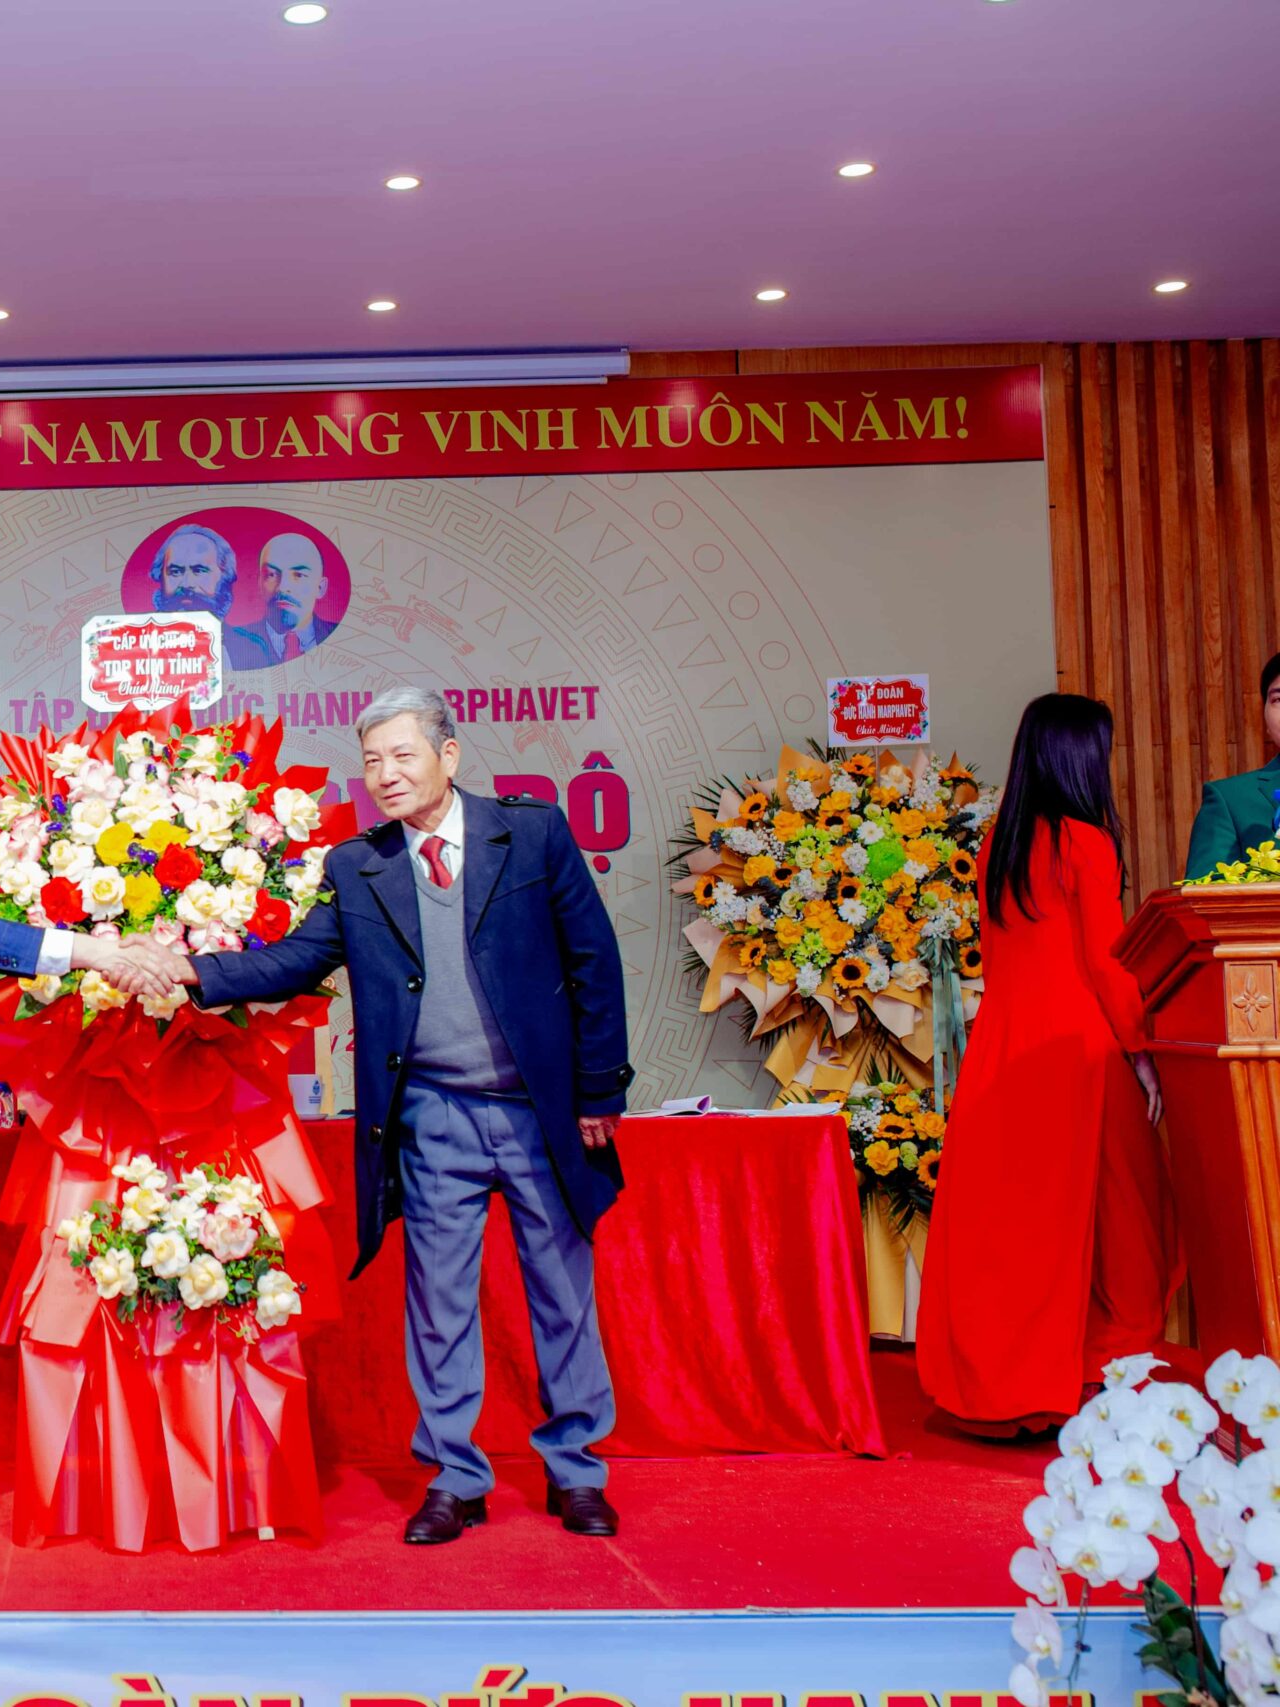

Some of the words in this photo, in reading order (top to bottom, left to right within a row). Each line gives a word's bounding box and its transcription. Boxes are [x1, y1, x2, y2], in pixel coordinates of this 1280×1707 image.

[20, 420, 160, 464] NAM
[178, 412, 404, 470] QUANG
[420, 408, 580, 453] VINH
[597, 392, 786, 449] MUÔN
[805, 395, 969, 443] NĂM!
[112, 630, 136, 650] CẤP
[442, 685, 600, 723] RPHAVET
